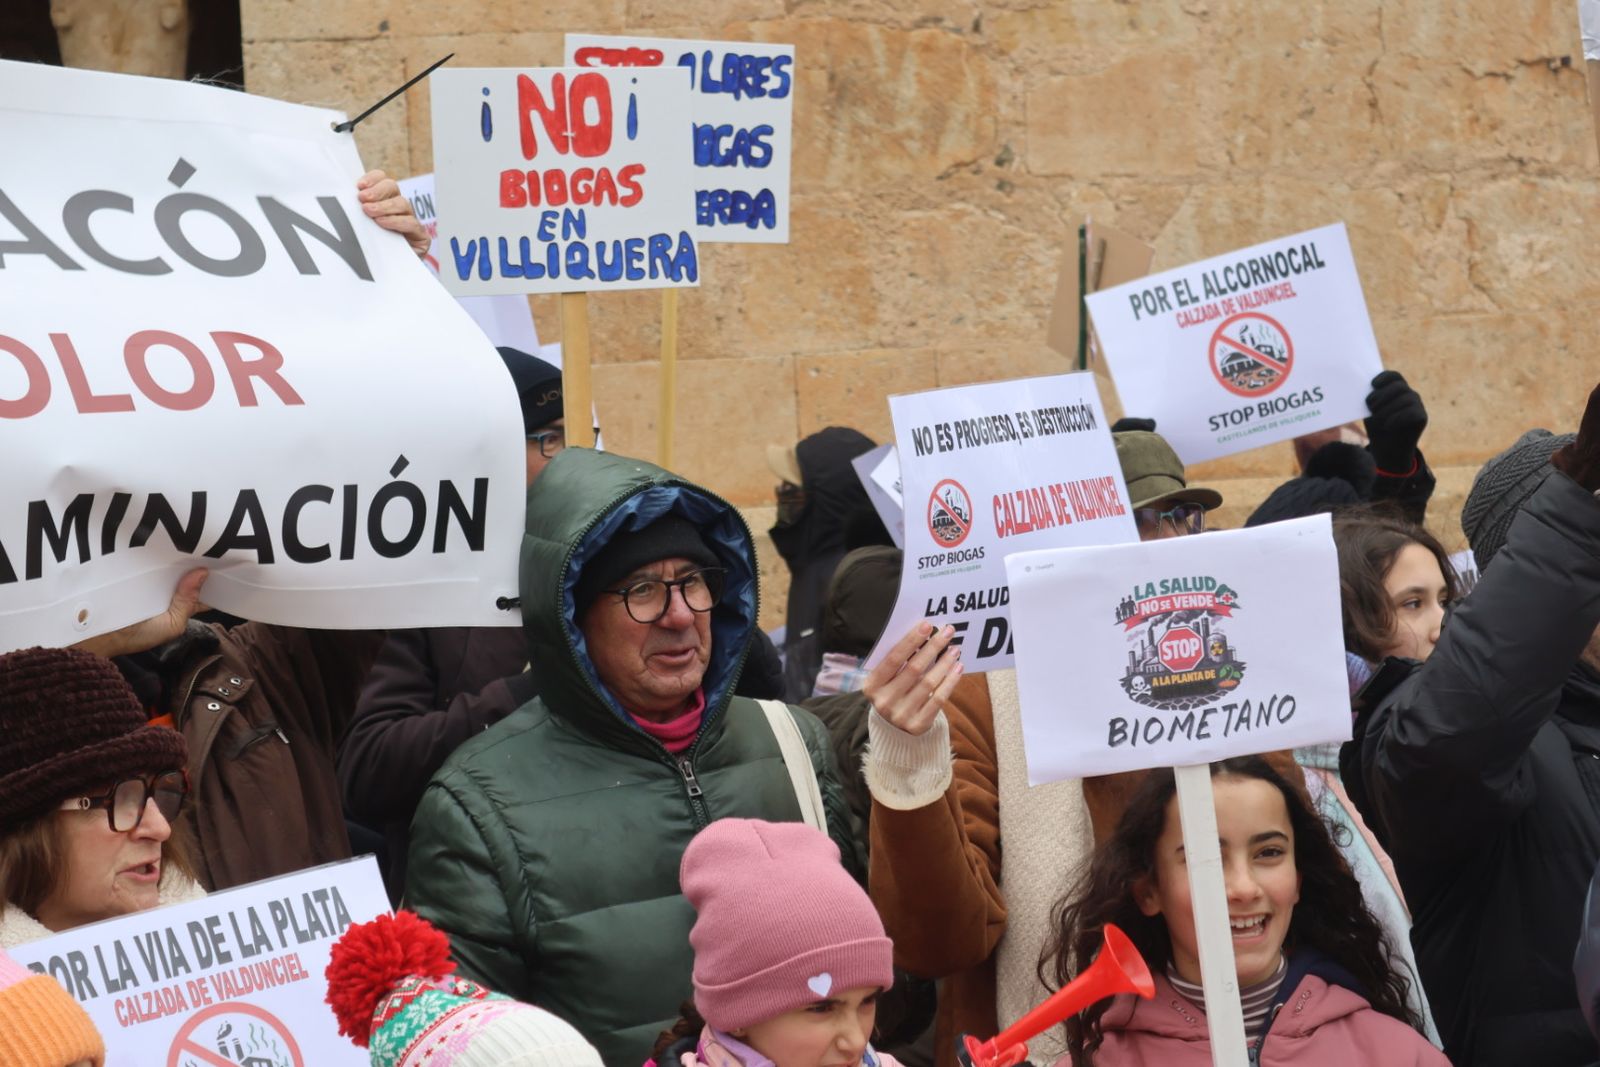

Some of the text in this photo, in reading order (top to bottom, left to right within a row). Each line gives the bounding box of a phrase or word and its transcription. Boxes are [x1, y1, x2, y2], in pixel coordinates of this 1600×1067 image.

[692, 122, 775, 168] OGAS
[499, 163, 646, 209] BIOGAS
[537, 207, 587, 242] EN
[450, 231, 699, 283] VILLIQUERA
[1129, 242, 1326, 321] POR EL ALCORNOCAL
[1175, 281, 1298, 329] CALZADA DE VALDUNCIEL
[537, 387, 563, 406] JO
[1208, 386, 1324, 432] STOP BIOGAS
[912, 398, 1098, 457] NO ES PROGRESO, ES DESTRUCCIÓN
[0, 454, 490, 585] MINACIÓN
[993, 476, 1127, 539] CALZADA DE VALDUNCIEL
[918, 546, 985, 570] STOP BIOGAS
[925, 586, 1010, 617] LA SALUD
[1134, 576, 1217, 601] LA SALUD
[1140, 594, 1214, 616] NO SE VENDE
[976, 617, 1015, 659] D
[1162, 637, 1200, 661] STOP
[1152, 669, 1216, 687] A LA PLANTA DE
[1108, 694, 1297, 748] BIOMETANO
[93, 938, 140, 994] LA
[135, 927, 191, 984] VIA
[187, 915, 233, 970] DE
[228, 901, 274, 959] LA
[267, 886, 353, 948] PLATA
[114, 952, 310, 1028] CALZADA DE VALDUNCIEL
